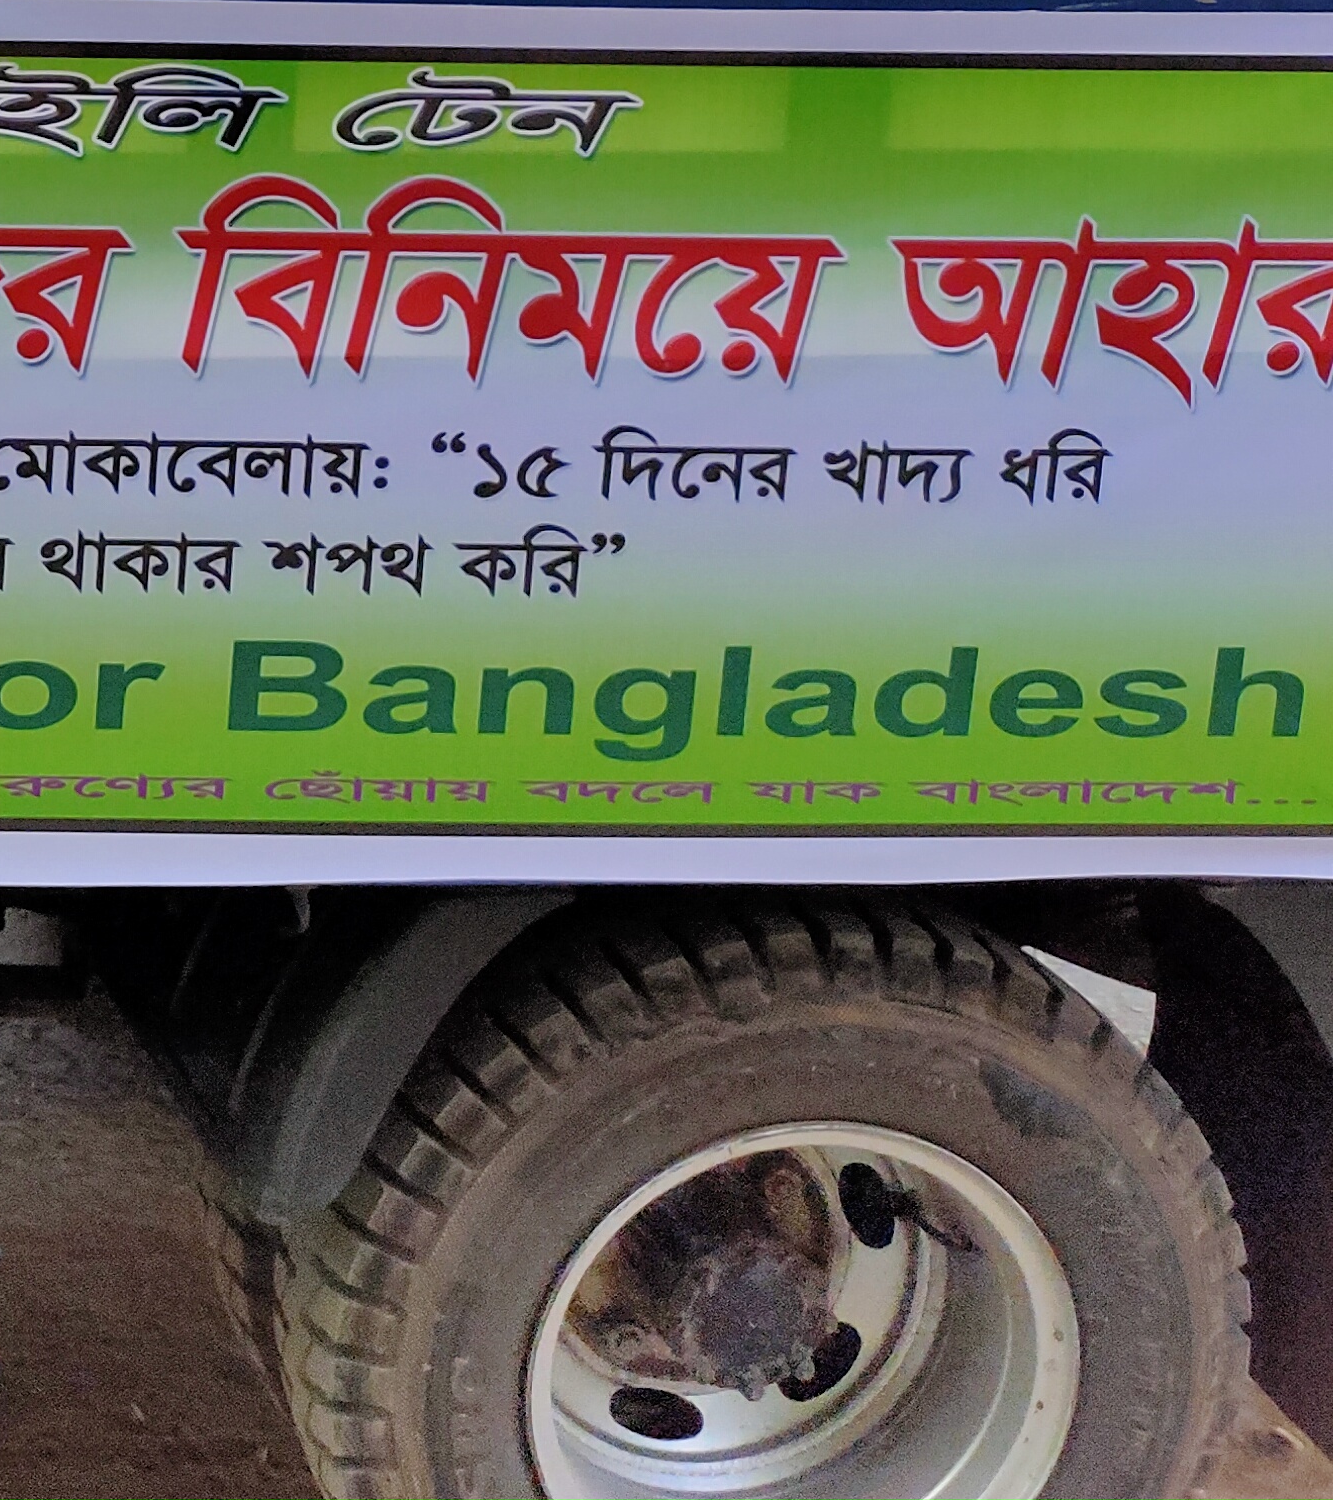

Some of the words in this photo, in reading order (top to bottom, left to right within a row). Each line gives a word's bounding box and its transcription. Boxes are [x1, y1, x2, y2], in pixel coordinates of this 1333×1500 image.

[333, 67, 644, 156] টেন
[176, 174, 847, 386] বিনিময়ে
[593, 425, 796, 502] দিনের
[823, 440, 973, 504] খাদ্য
[1000, 428, 1113, 505] ধরি
[40, 530, 240, 594] থাকার
[263, 534, 433, 597] শপথ
[454, 524, 626, 598] করি”
[227, 639, 1305, 763] Bangladesh
[519, 779, 719, 805] বদলে
[746, 779, 888, 805] যাক
